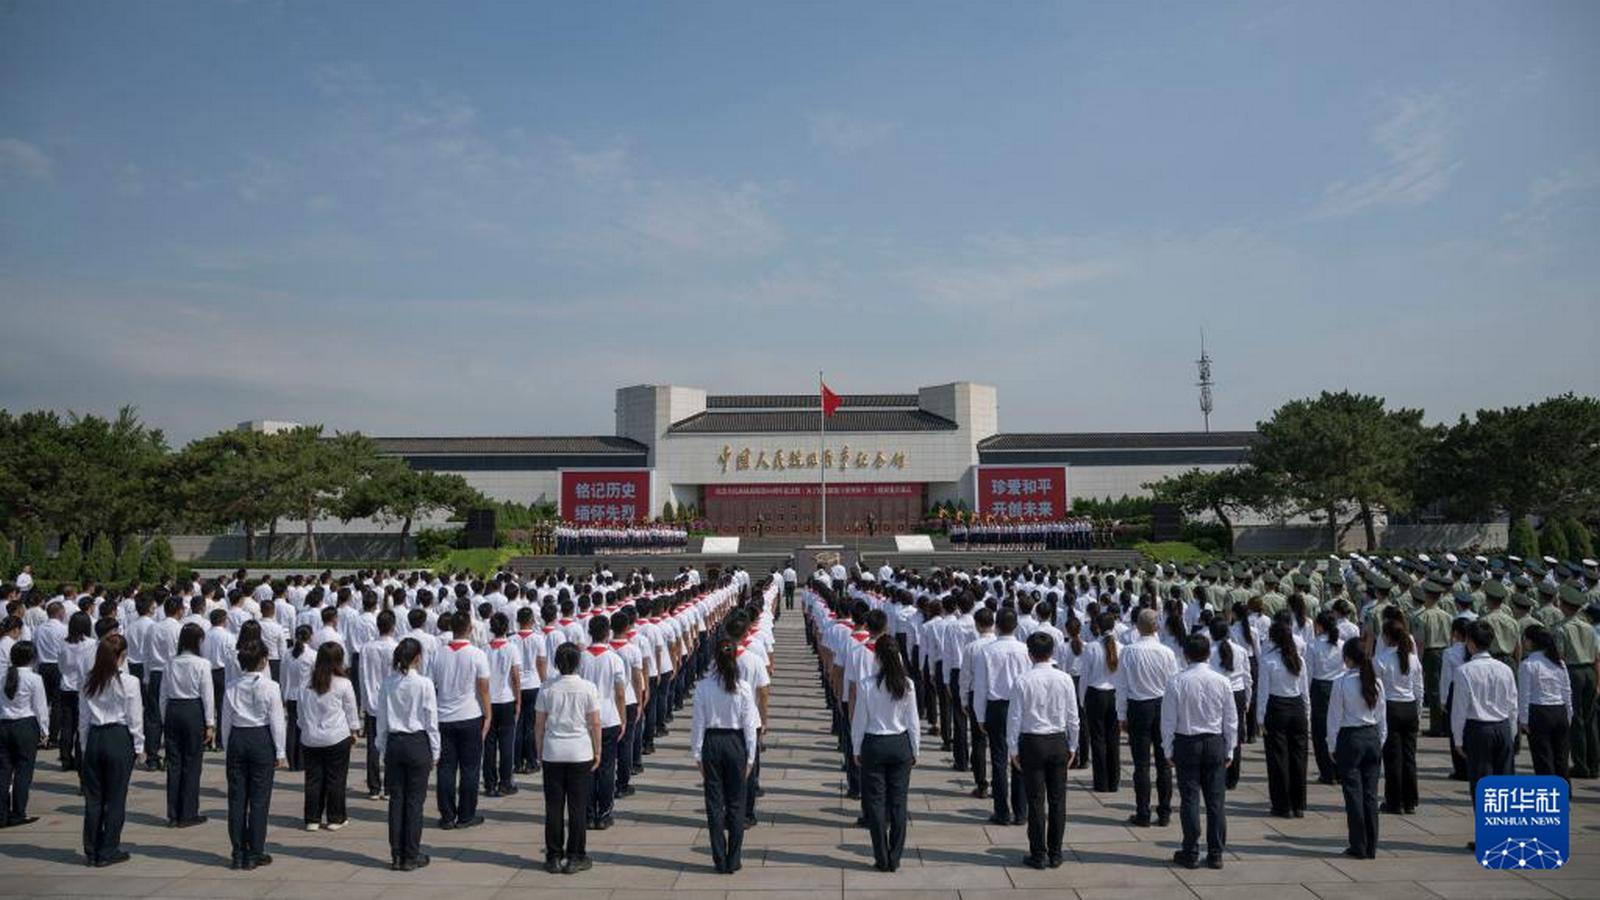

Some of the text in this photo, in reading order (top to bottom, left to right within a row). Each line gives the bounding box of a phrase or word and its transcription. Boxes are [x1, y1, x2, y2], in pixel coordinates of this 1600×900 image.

[575, 482, 637, 499] 铭记历史
[992, 479, 1052, 496] 珍爱和平
[992, 501, 1053, 518] 开创未来
